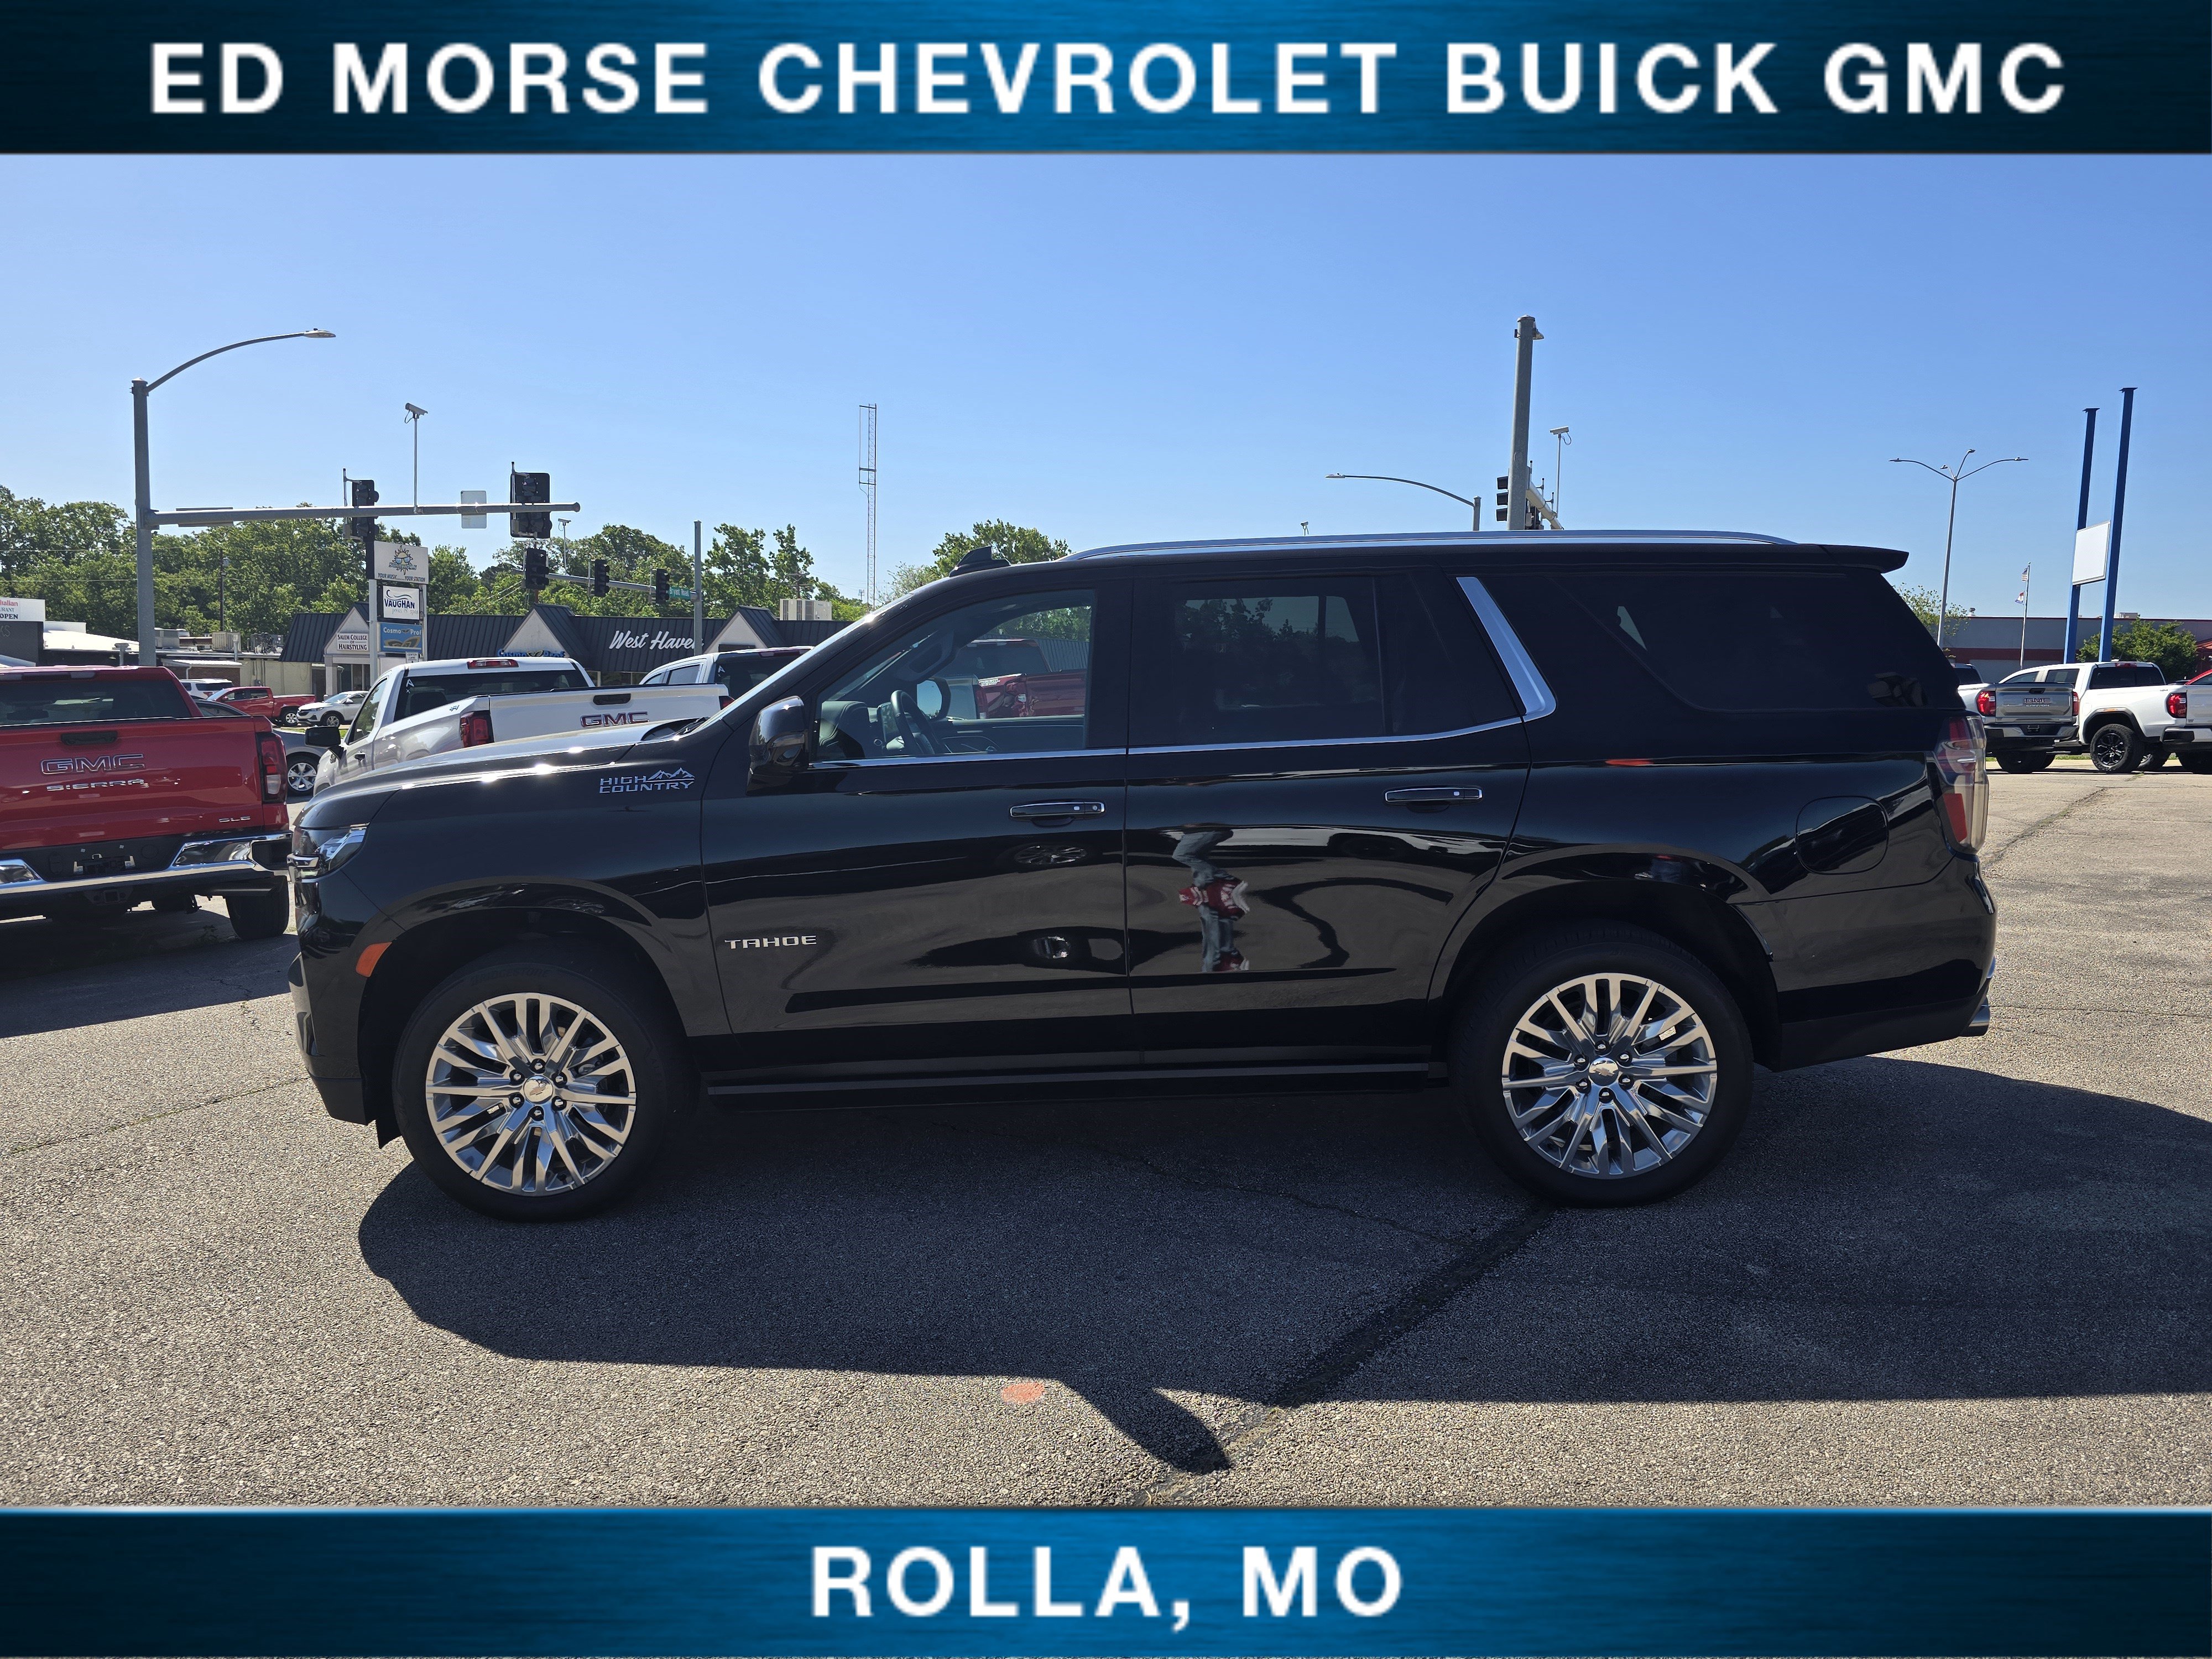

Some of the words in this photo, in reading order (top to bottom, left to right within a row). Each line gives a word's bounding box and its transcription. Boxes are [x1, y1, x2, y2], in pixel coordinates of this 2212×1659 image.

[384, 598, 415, 609] VAUGHAN
[609, 630, 649, 649] West
[580, 711, 650, 728] GMC
[40, 753, 145, 775] GMC
[46, 779, 145, 791] SIERRA
[599, 781, 695, 794] COUNTRY
[600, 775, 647, 786] HIGH
[724, 935, 817, 950] TAHOE
